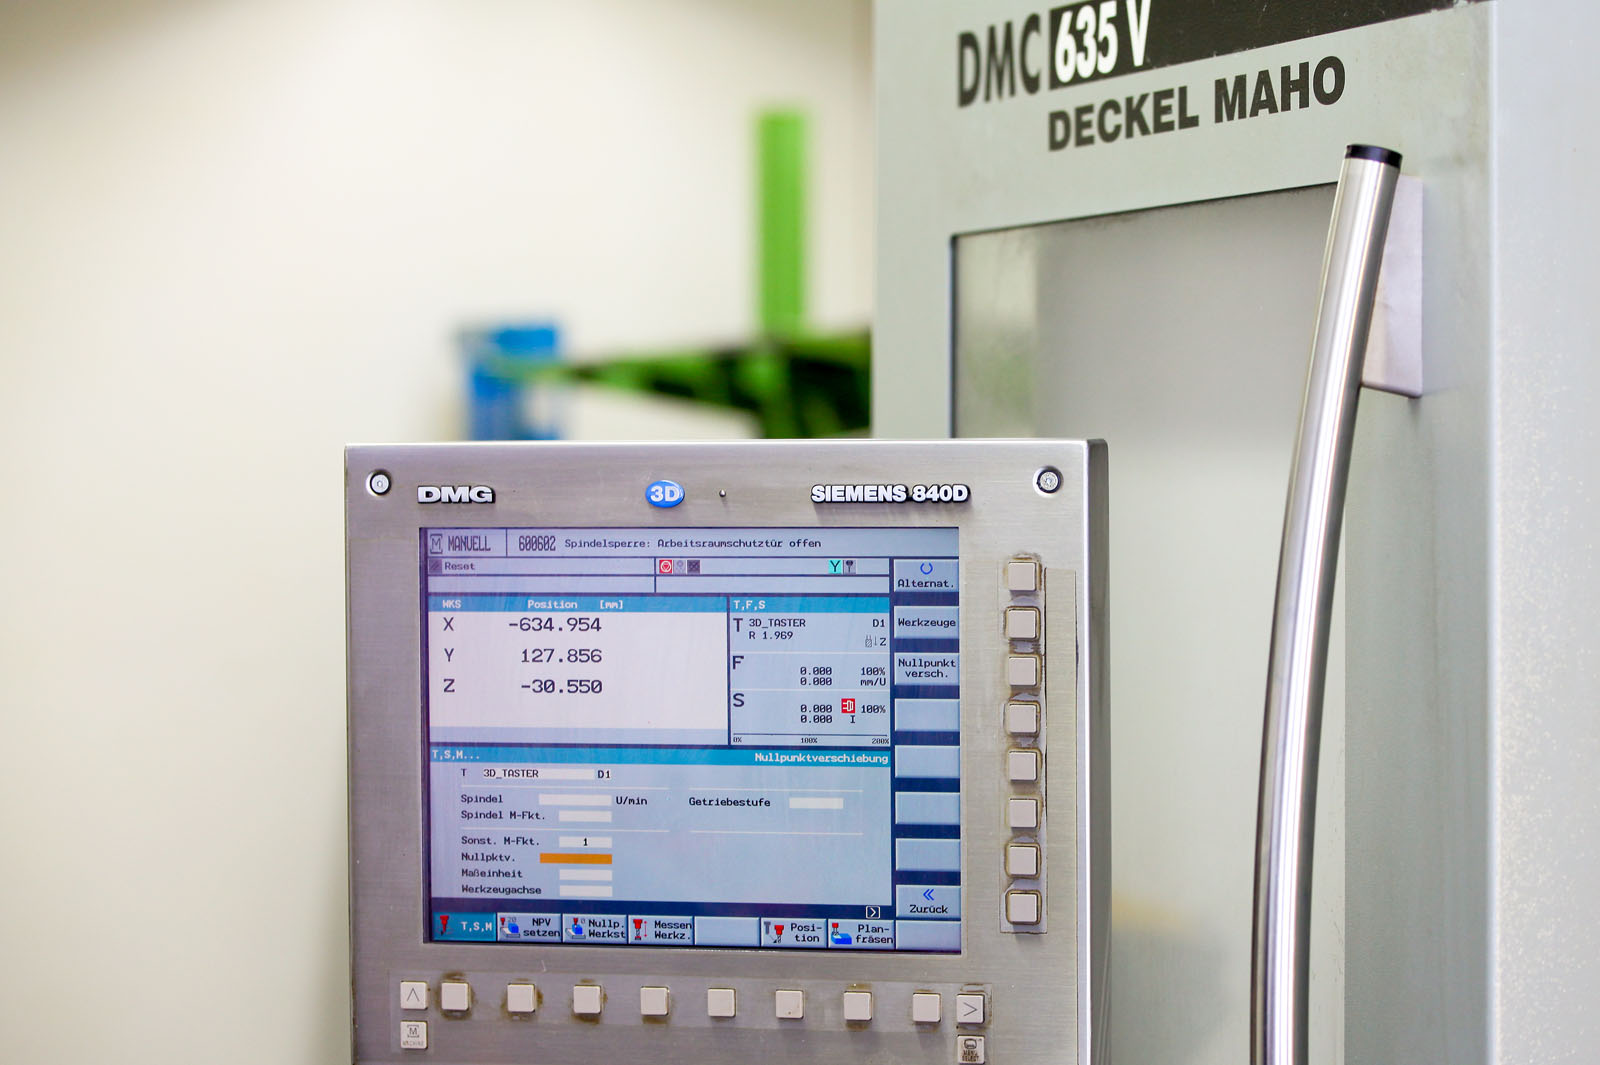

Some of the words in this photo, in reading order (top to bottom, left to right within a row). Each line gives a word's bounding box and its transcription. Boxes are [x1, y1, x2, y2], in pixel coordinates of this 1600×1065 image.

[957, 12, 1043, 108] DMC
[1054, 1, 1119, 83] 635
[1125, 0, 1152, 67] V
[1048, 85, 1200, 152] DECKEL
[1213, 55, 1346, 123] MAHO
[417, 486, 495, 504] DMG
[650, 484, 682, 502] 3D
[811, 485, 907, 502] SIEMENS
[912, 485, 969, 502] 840D
[448, 535, 491, 551] MANUELL
[518, 535, 556, 551] 600602
[565, 538, 651, 550] Spindelsperre:
[657, 537, 783, 549] Arbeitsraumschutztür
[789, 538, 821, 548] offen
[444, 561, 475, 571] Reset
[898, 578, 955, 589] Alternat.
[442, 600, 461, 609] WKS
[527, 600, 578, 609] Position
[600, 600, 624, 610] [mm]
[733, 600, 766, 610] T,F,S
[443, 617, 454, 631] X
[508, 617, 602, 632] -634.954
[733, 618, 743, 632] T
[748, 618, 806, 629] 3D_TASTER
[872, 619, 885, 628] D1
[897, 618, 956, 629] Werkzeuge
[748, 631, 756, 640] R
[762, 631, 794, 640] 1.969
[879, 637, 887, 646] Z
[443, 648, 454, 662] Y
[521, 648, 602, 663] 127.856
[732, 655, 744, 670] F
[898, 658, 956, 669] Nullpunkt
[800, 666, 832, 676] 0.000
[860, 667, 886, 676] 100%
[905, 669, 949, 678] versch.
[443, 678, 455, 693] Z
[521, 678, 603, 694] -30.550
[800, 677, 832, 686] 0.000
[860, 678, 887, 687] mm/U
[732, 693, 745, 708] S
[800, 704, 833, 713] 0.000
[860, 704, 886, 714] 100%
[800, 715, 833, 724] 0.000
[432, 749, 480, 760] T,S,M...
[754, 752, 889, 765] Nullpunktverschiebung
[461, 768, 466, 777] T
[483, 769, 539, 779] 3D_TASTER
[597, 770, 611, 779] D1
[461, 794, 503, 804] Spindel
[615, 796, 648, 806] U/min
[688, 797, 771, 807] Getriebestufe
[461, 810, 503, 820] Spindel
[509, 811, 546, 820] M-Fkt.
[461, 836, 497, 846] Sonst.
[503, 837, 540, 846] M-Fkt.
[583, 837, 588, 847] 1
[461, 853, 516, 863] Nullpktv.
[461, 869, 523, 879] Maßeinheit
[461, 885, 542, 896] Werkzeugachse
[909, 904, 949, 915] Zurück
[461, 921, 493, 932] T,S,M
[532, 918, 551, 926] NPV
[588, 919, 625, 929] Nullp.
[654, 920, 692, 929] Messen
[790, 923, 822, 933] Posi-
[858, 924, 890, 934] Plan-
[523, 929, 561, 938] setzen
[588, 930, 626, 939] Werkst
[654, 931, 691, 940] Werkz.
[794, 934, 820, 943] tion
[855, 935, 894, 945] fräsen
